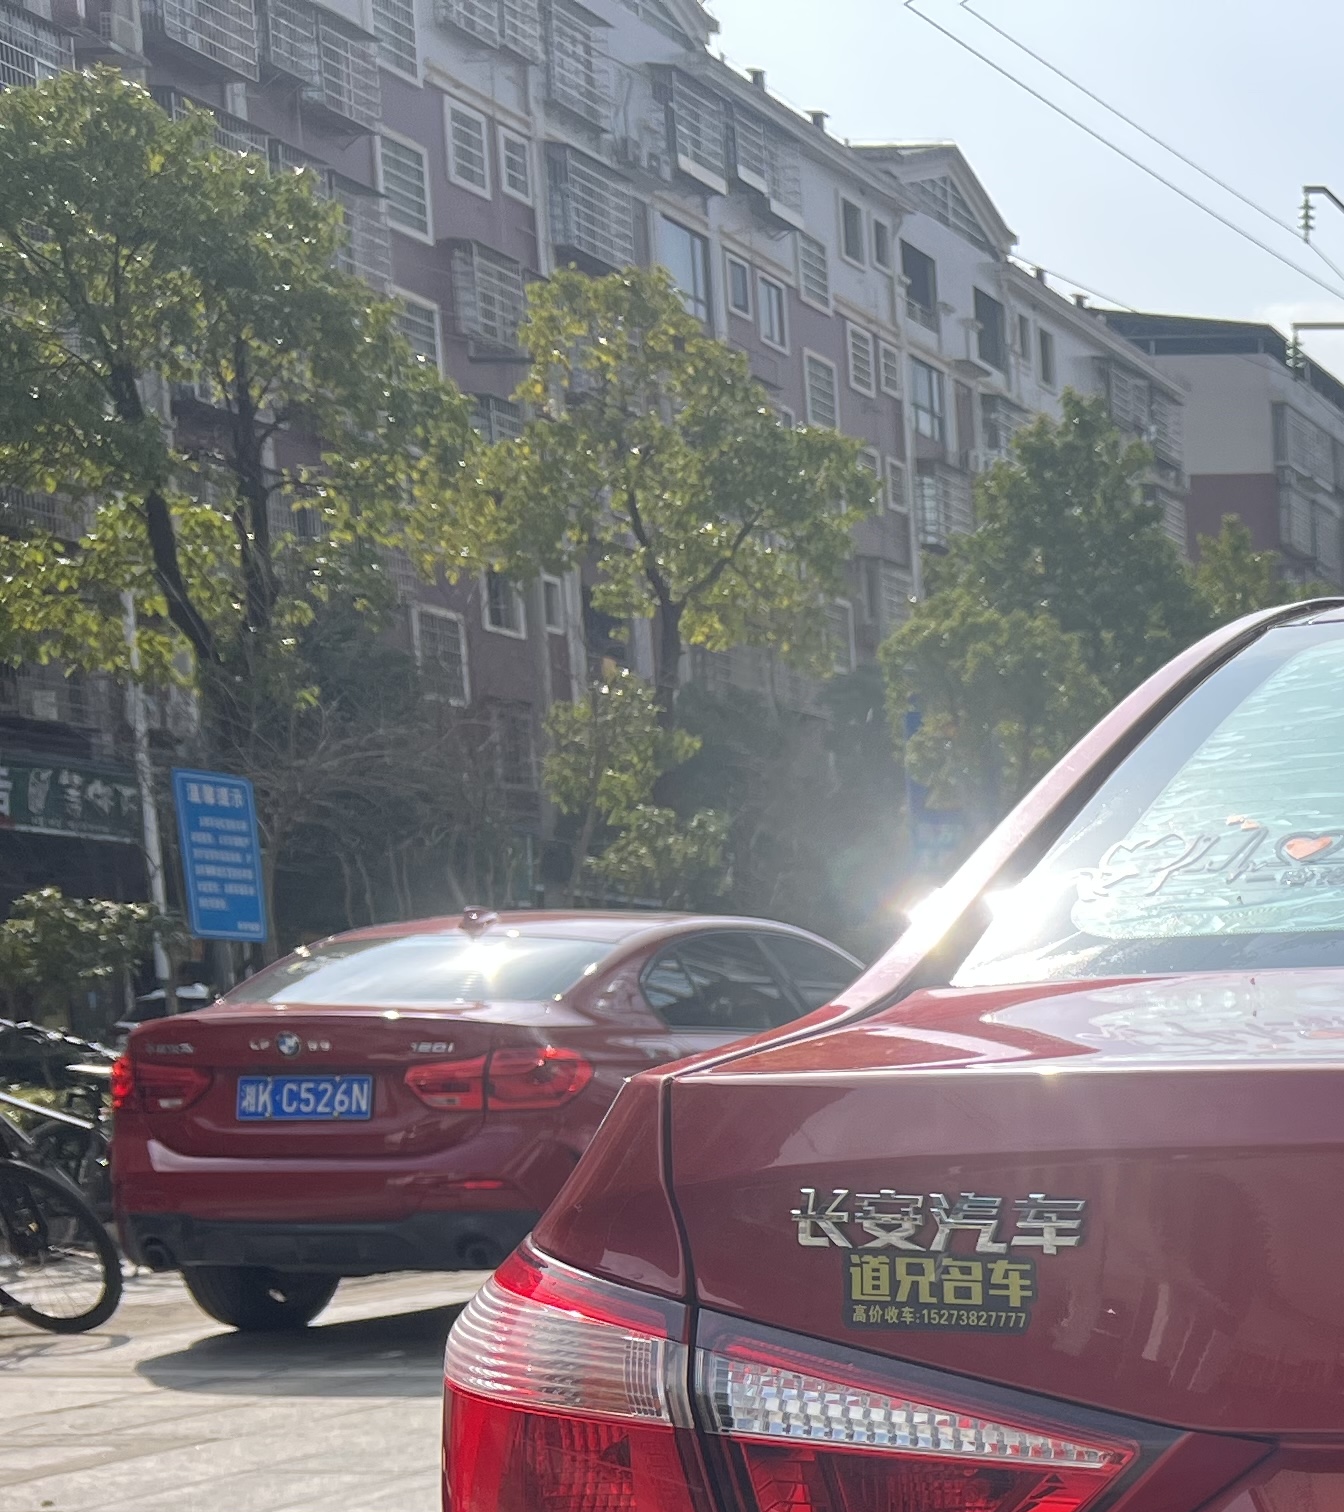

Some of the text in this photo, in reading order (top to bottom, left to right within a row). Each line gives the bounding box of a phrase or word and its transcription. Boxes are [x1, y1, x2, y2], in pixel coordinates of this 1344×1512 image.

[790, 1187, 1087, 1256] 长安汽车
[849, 1254, 1034, 1308] 道兄名车
